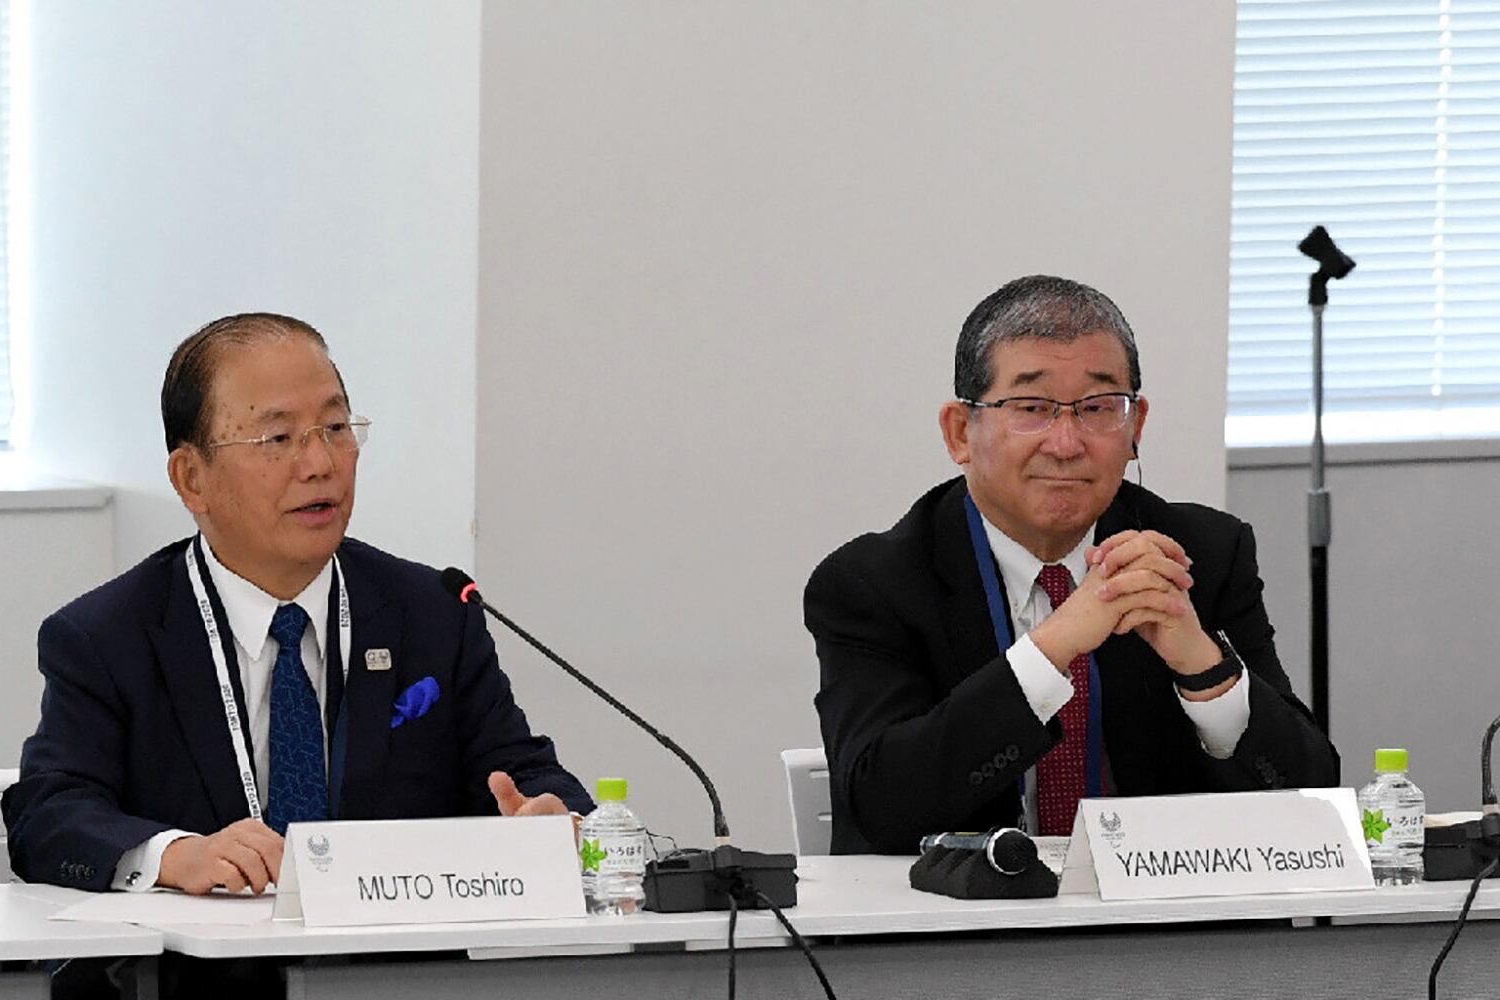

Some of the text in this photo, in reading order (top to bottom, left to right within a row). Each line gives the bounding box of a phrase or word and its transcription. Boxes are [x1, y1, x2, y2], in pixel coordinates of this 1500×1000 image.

[1116, 843, 1345, 877] YAMAWAKI Yasushi
[358, 871, 524, 900] MUTO Toshiro
